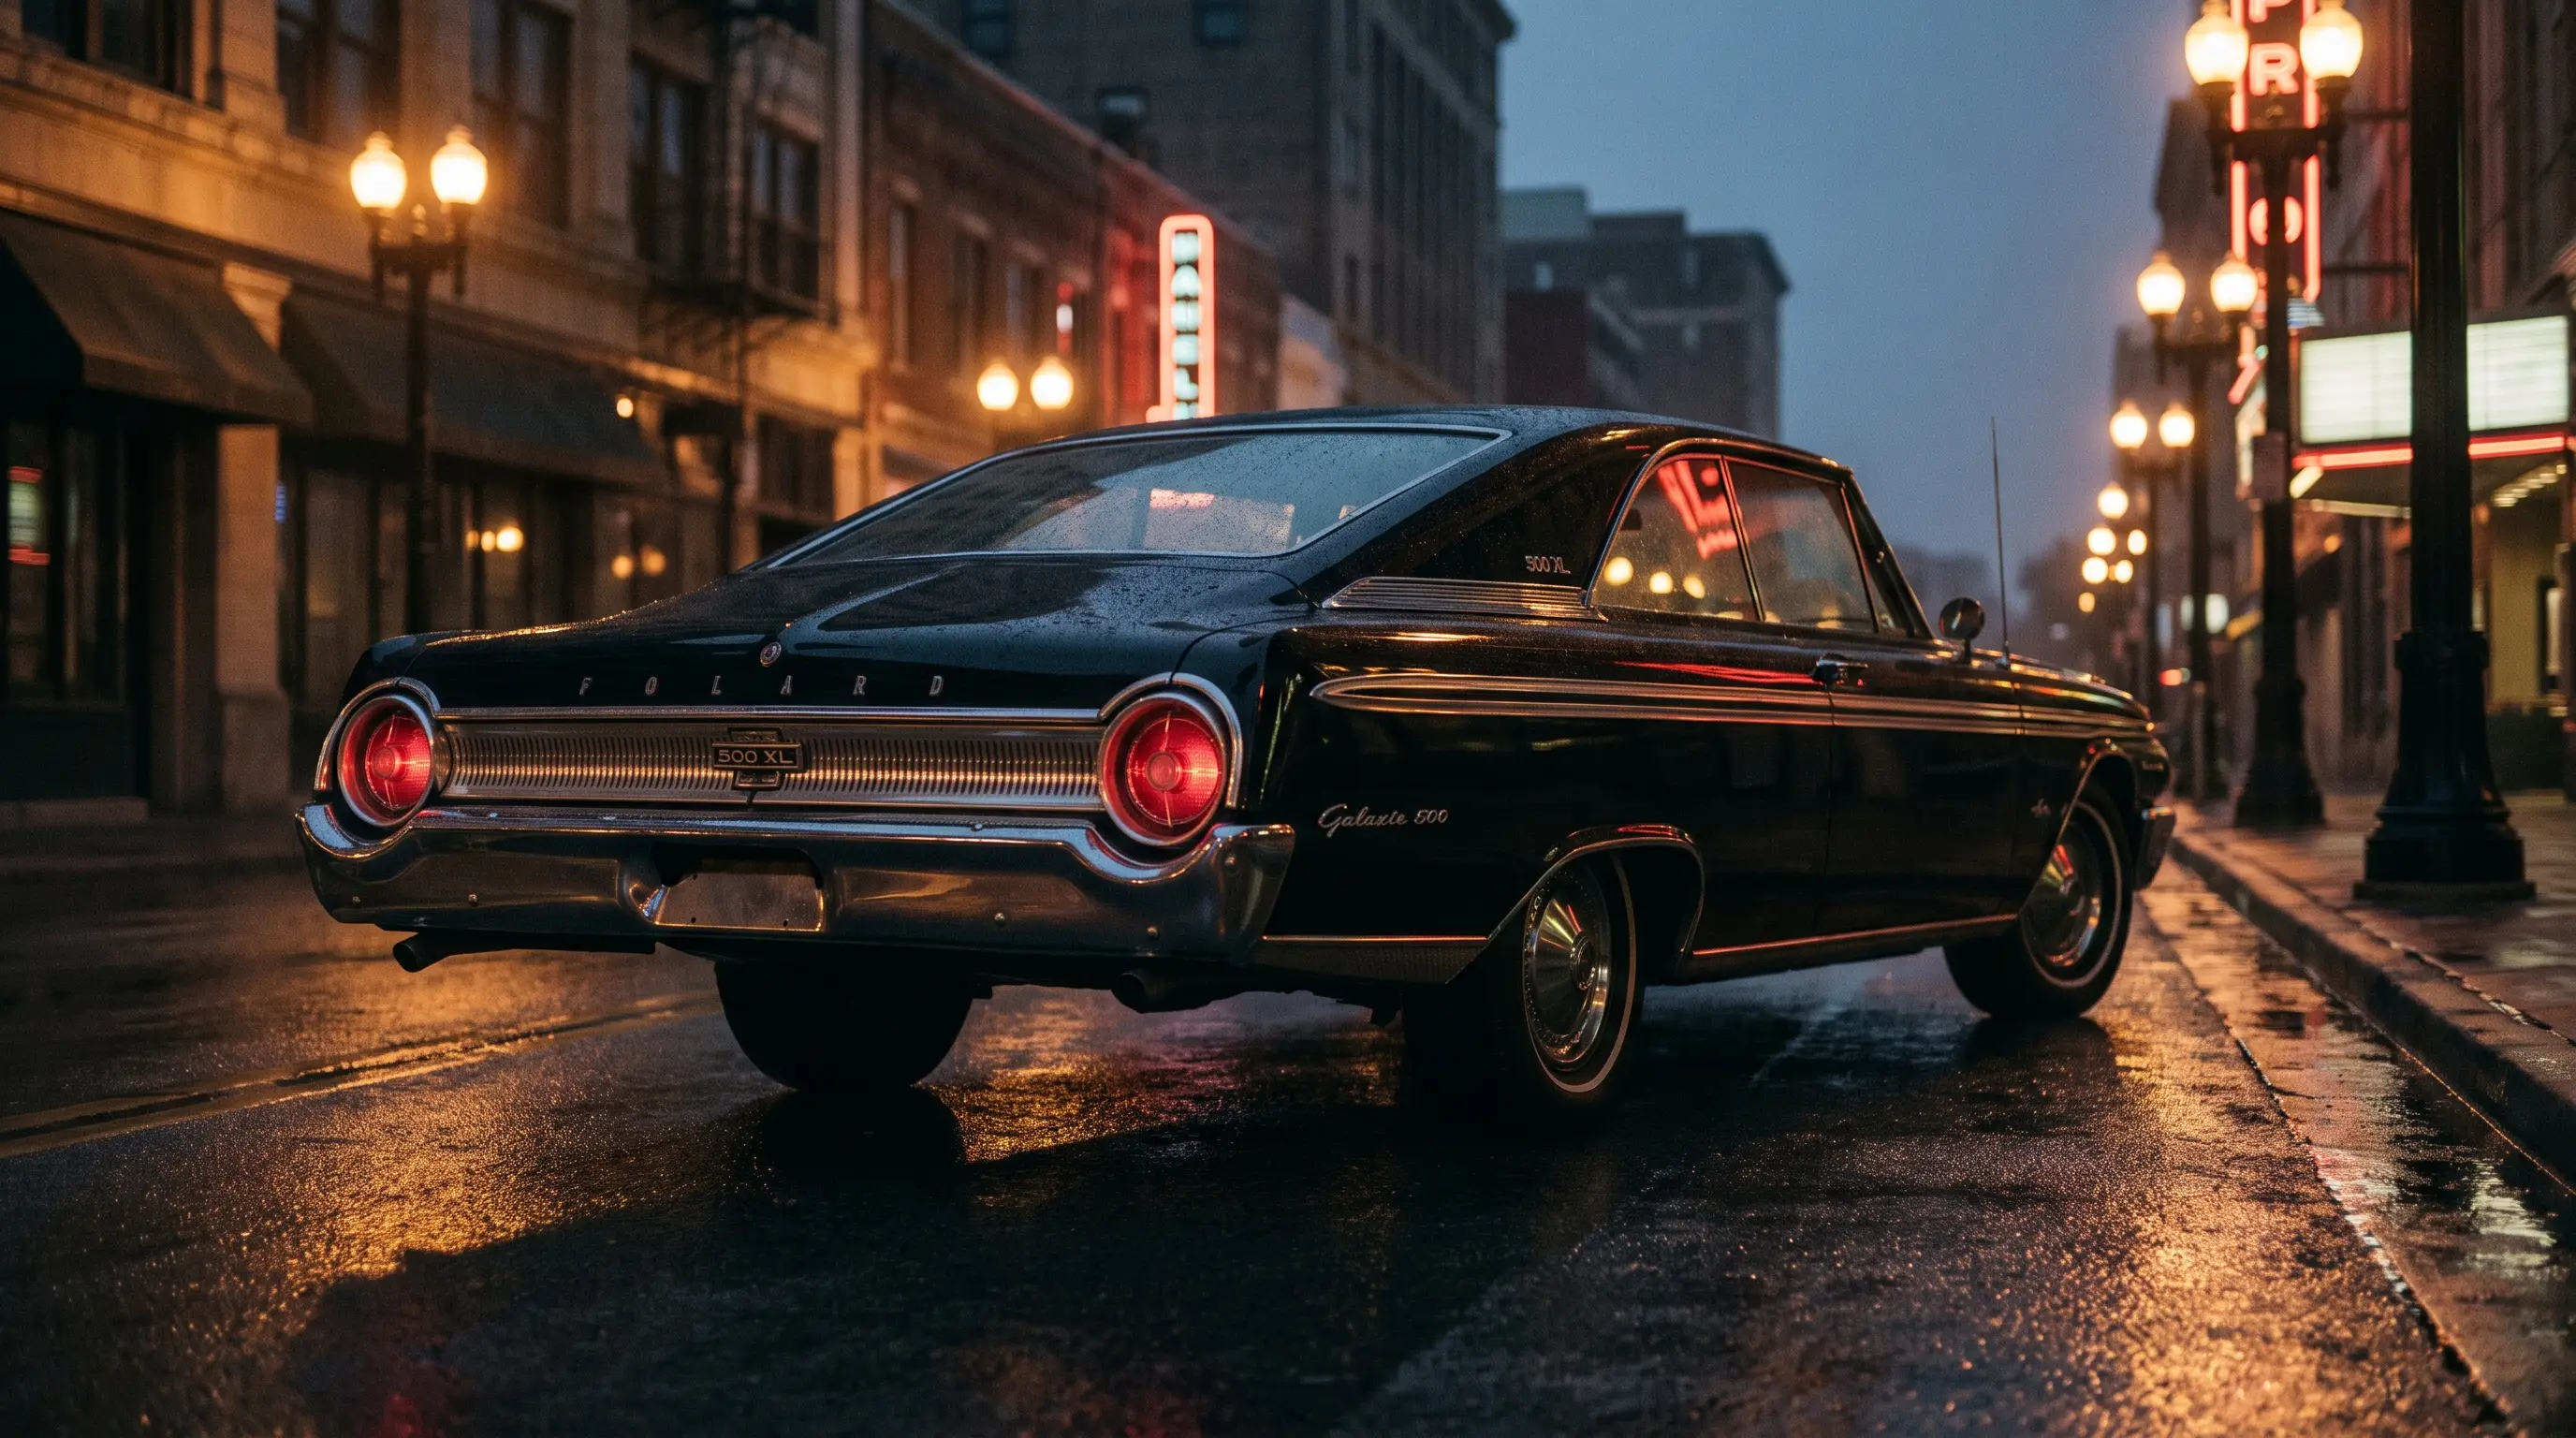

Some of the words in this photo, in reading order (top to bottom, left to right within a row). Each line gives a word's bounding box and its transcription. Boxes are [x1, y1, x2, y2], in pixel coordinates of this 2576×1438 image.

[1525, 555, 1551, 573] 500
[1549, 556, 1572, 574] XL
[578, 675, 944, 697] FOLARD
[718, 749, 757, 764] 500
[763, 750, 794, 764] XL
[1318, 803, 1408, 838] Galaxie
[1413, 809, 1449, 825] 500
